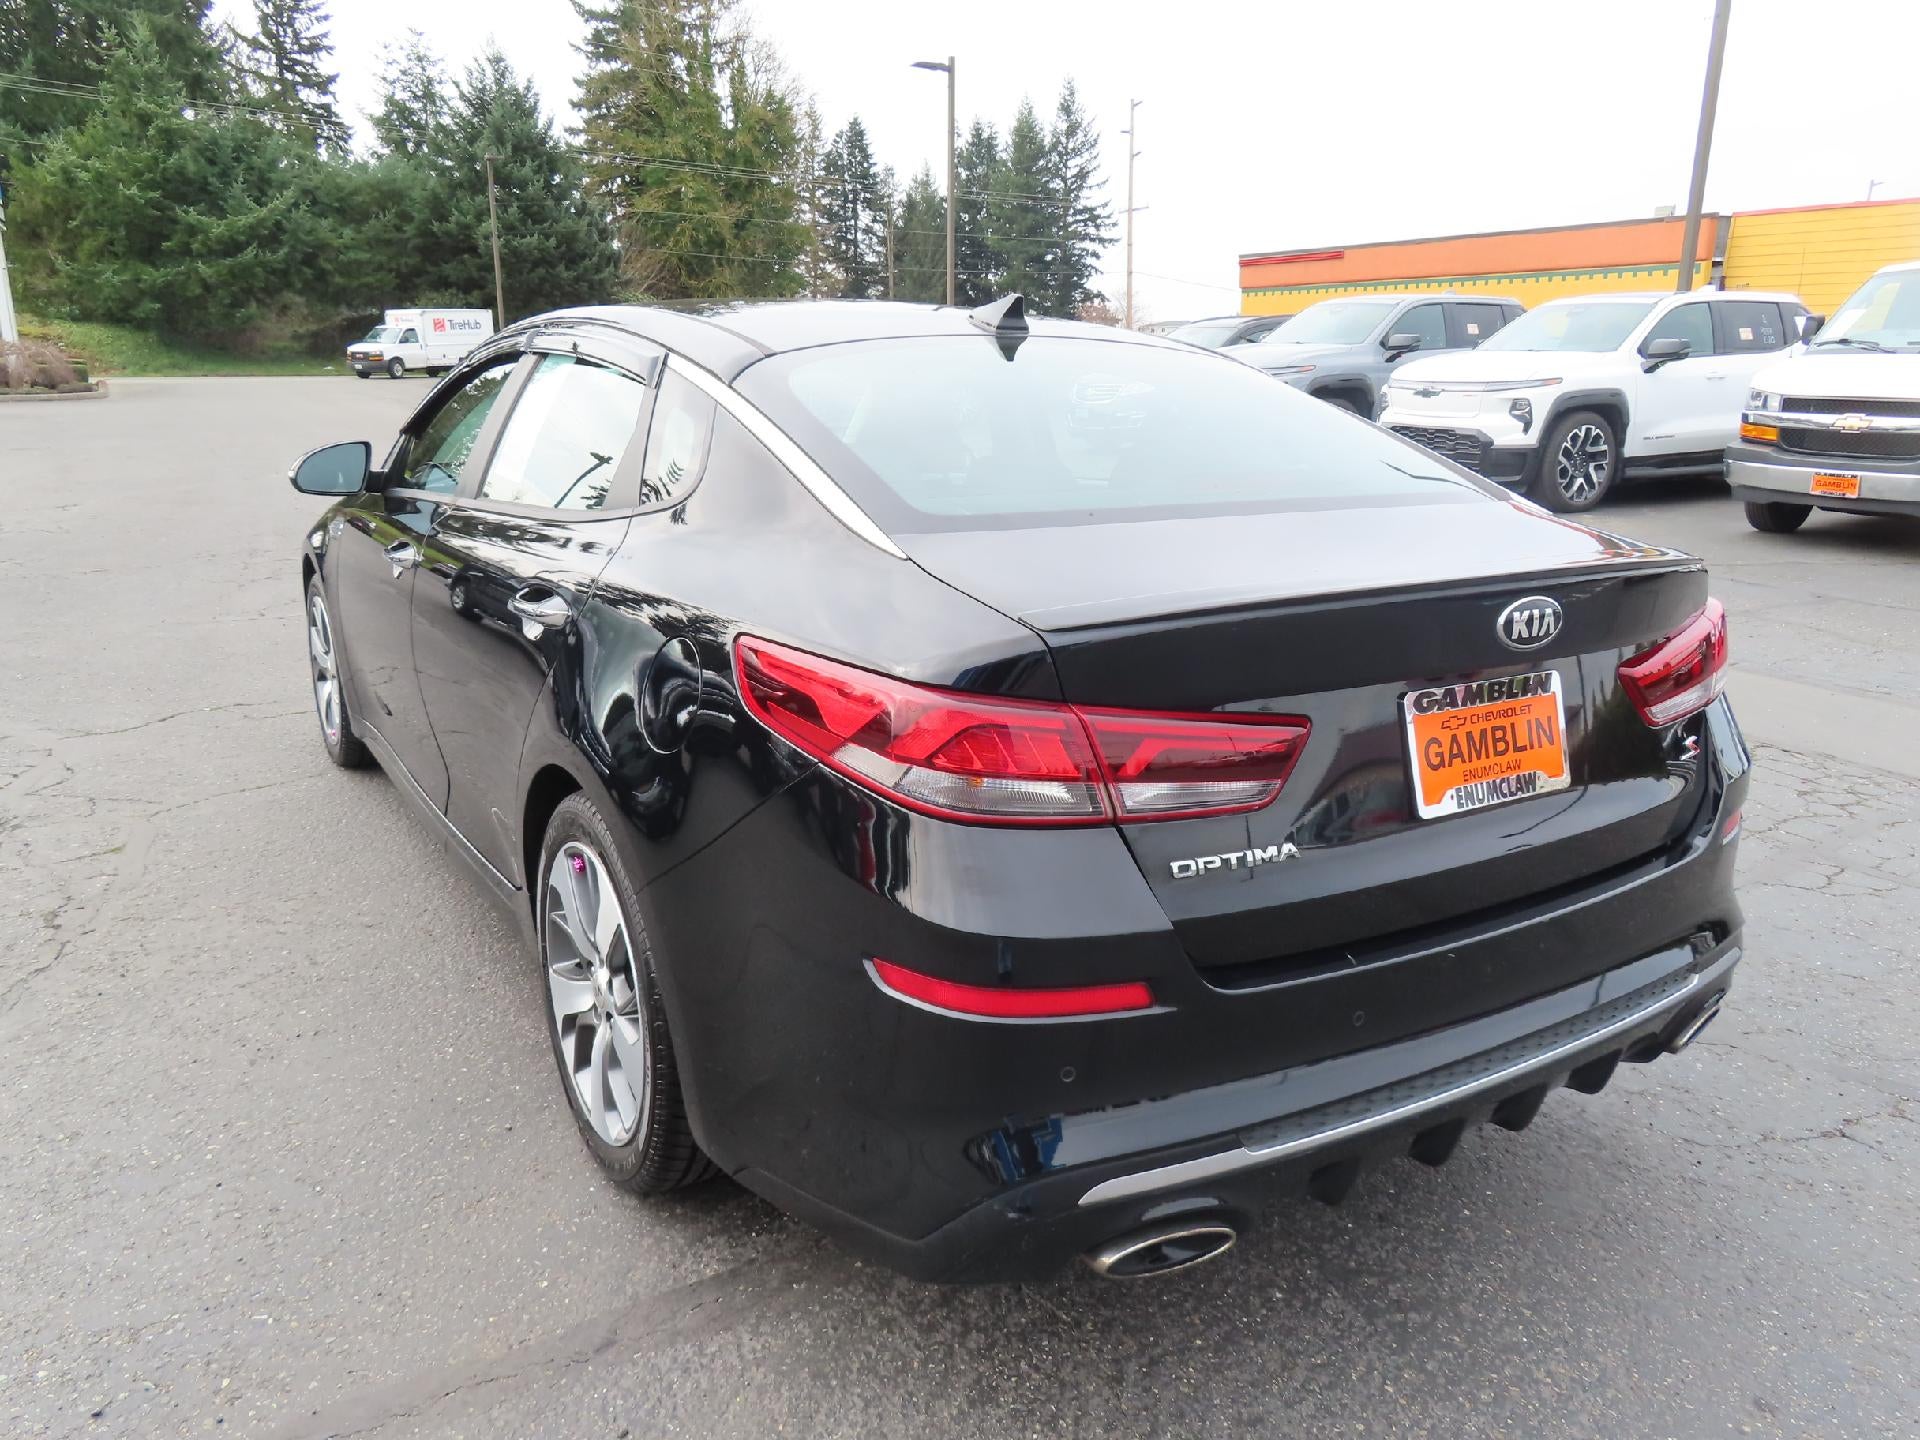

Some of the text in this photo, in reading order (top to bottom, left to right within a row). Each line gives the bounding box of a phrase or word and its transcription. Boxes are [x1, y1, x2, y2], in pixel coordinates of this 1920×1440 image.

[448, 319, 482, 331] TireHub
[1815, 480, 1857, 489] GAMBLIN
[1511, 608, 1555, 639] KIA
[1412, 672, 1553, 715] GAMBLIN
[1470, 704, 1533, 725] CHEVROLET
[1424, 716, 1555, 772] GAMBLIN
[1463, 759, 1522, 782] ENUMCLAW
[1455, 771, 1538, 809] ENUMCLAW
[1169, 842, 1302, 879] OPTIMA
